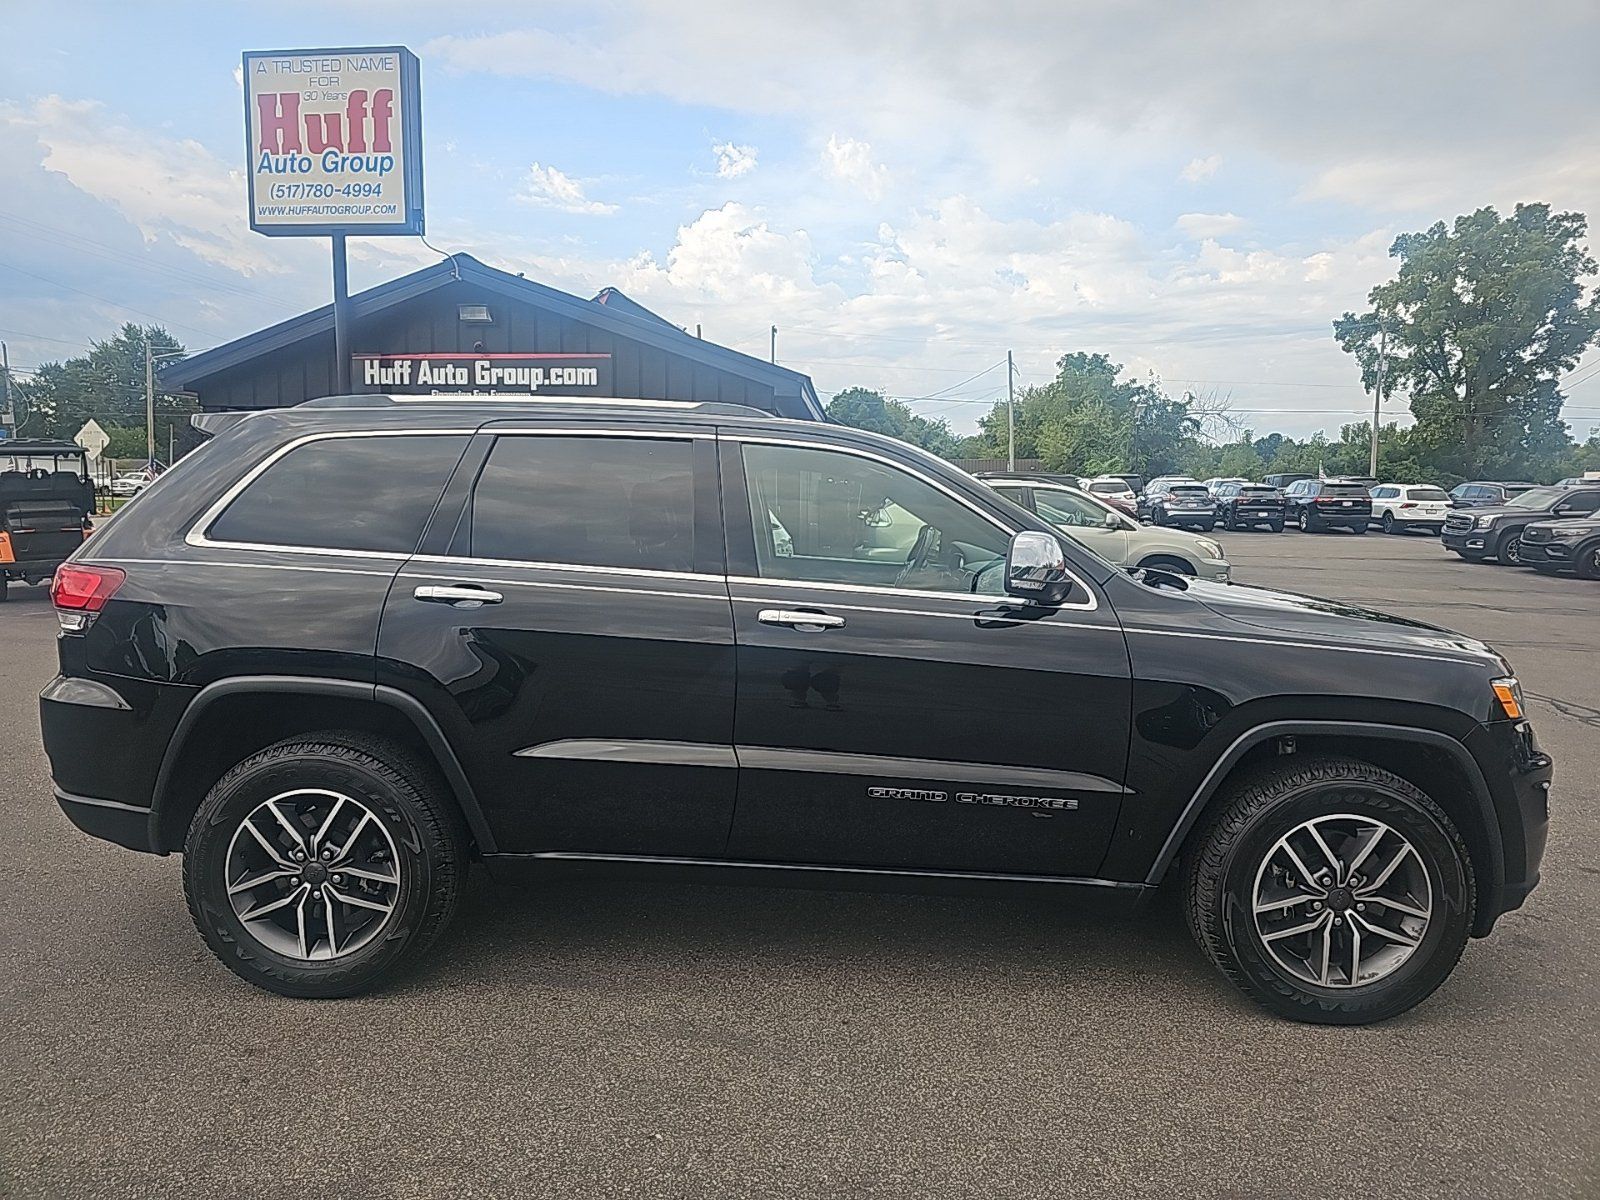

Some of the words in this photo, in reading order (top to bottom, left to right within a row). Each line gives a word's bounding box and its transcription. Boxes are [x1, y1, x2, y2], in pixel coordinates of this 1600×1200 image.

[257, 62, 267, 74] A
[272, 58, 342, 74] TRUSTED
[347, 57, 394, 72] NAME
[309, 76, 340, 87] FOR
[303, 91, 318, 101] 30
[322, 91, 348, 101] Years
[257, 88, 394, 155] Huff
[257, 152, 313, 174] Auto
[322, 151, 394, 177] Group
[270, 183, 382, 200] (517)780-4994
[258, 204, 397, 216] WWW.HUFFAUTOGROUP.COM
[364, 360, 412, 386] Huff
[417, 360, 469, 386] Auto
[474, 360, 598, 391] Group.com
[868, 786, 948, 802] GRAND
[956, 792, 1080, 810] CHEROKEE
